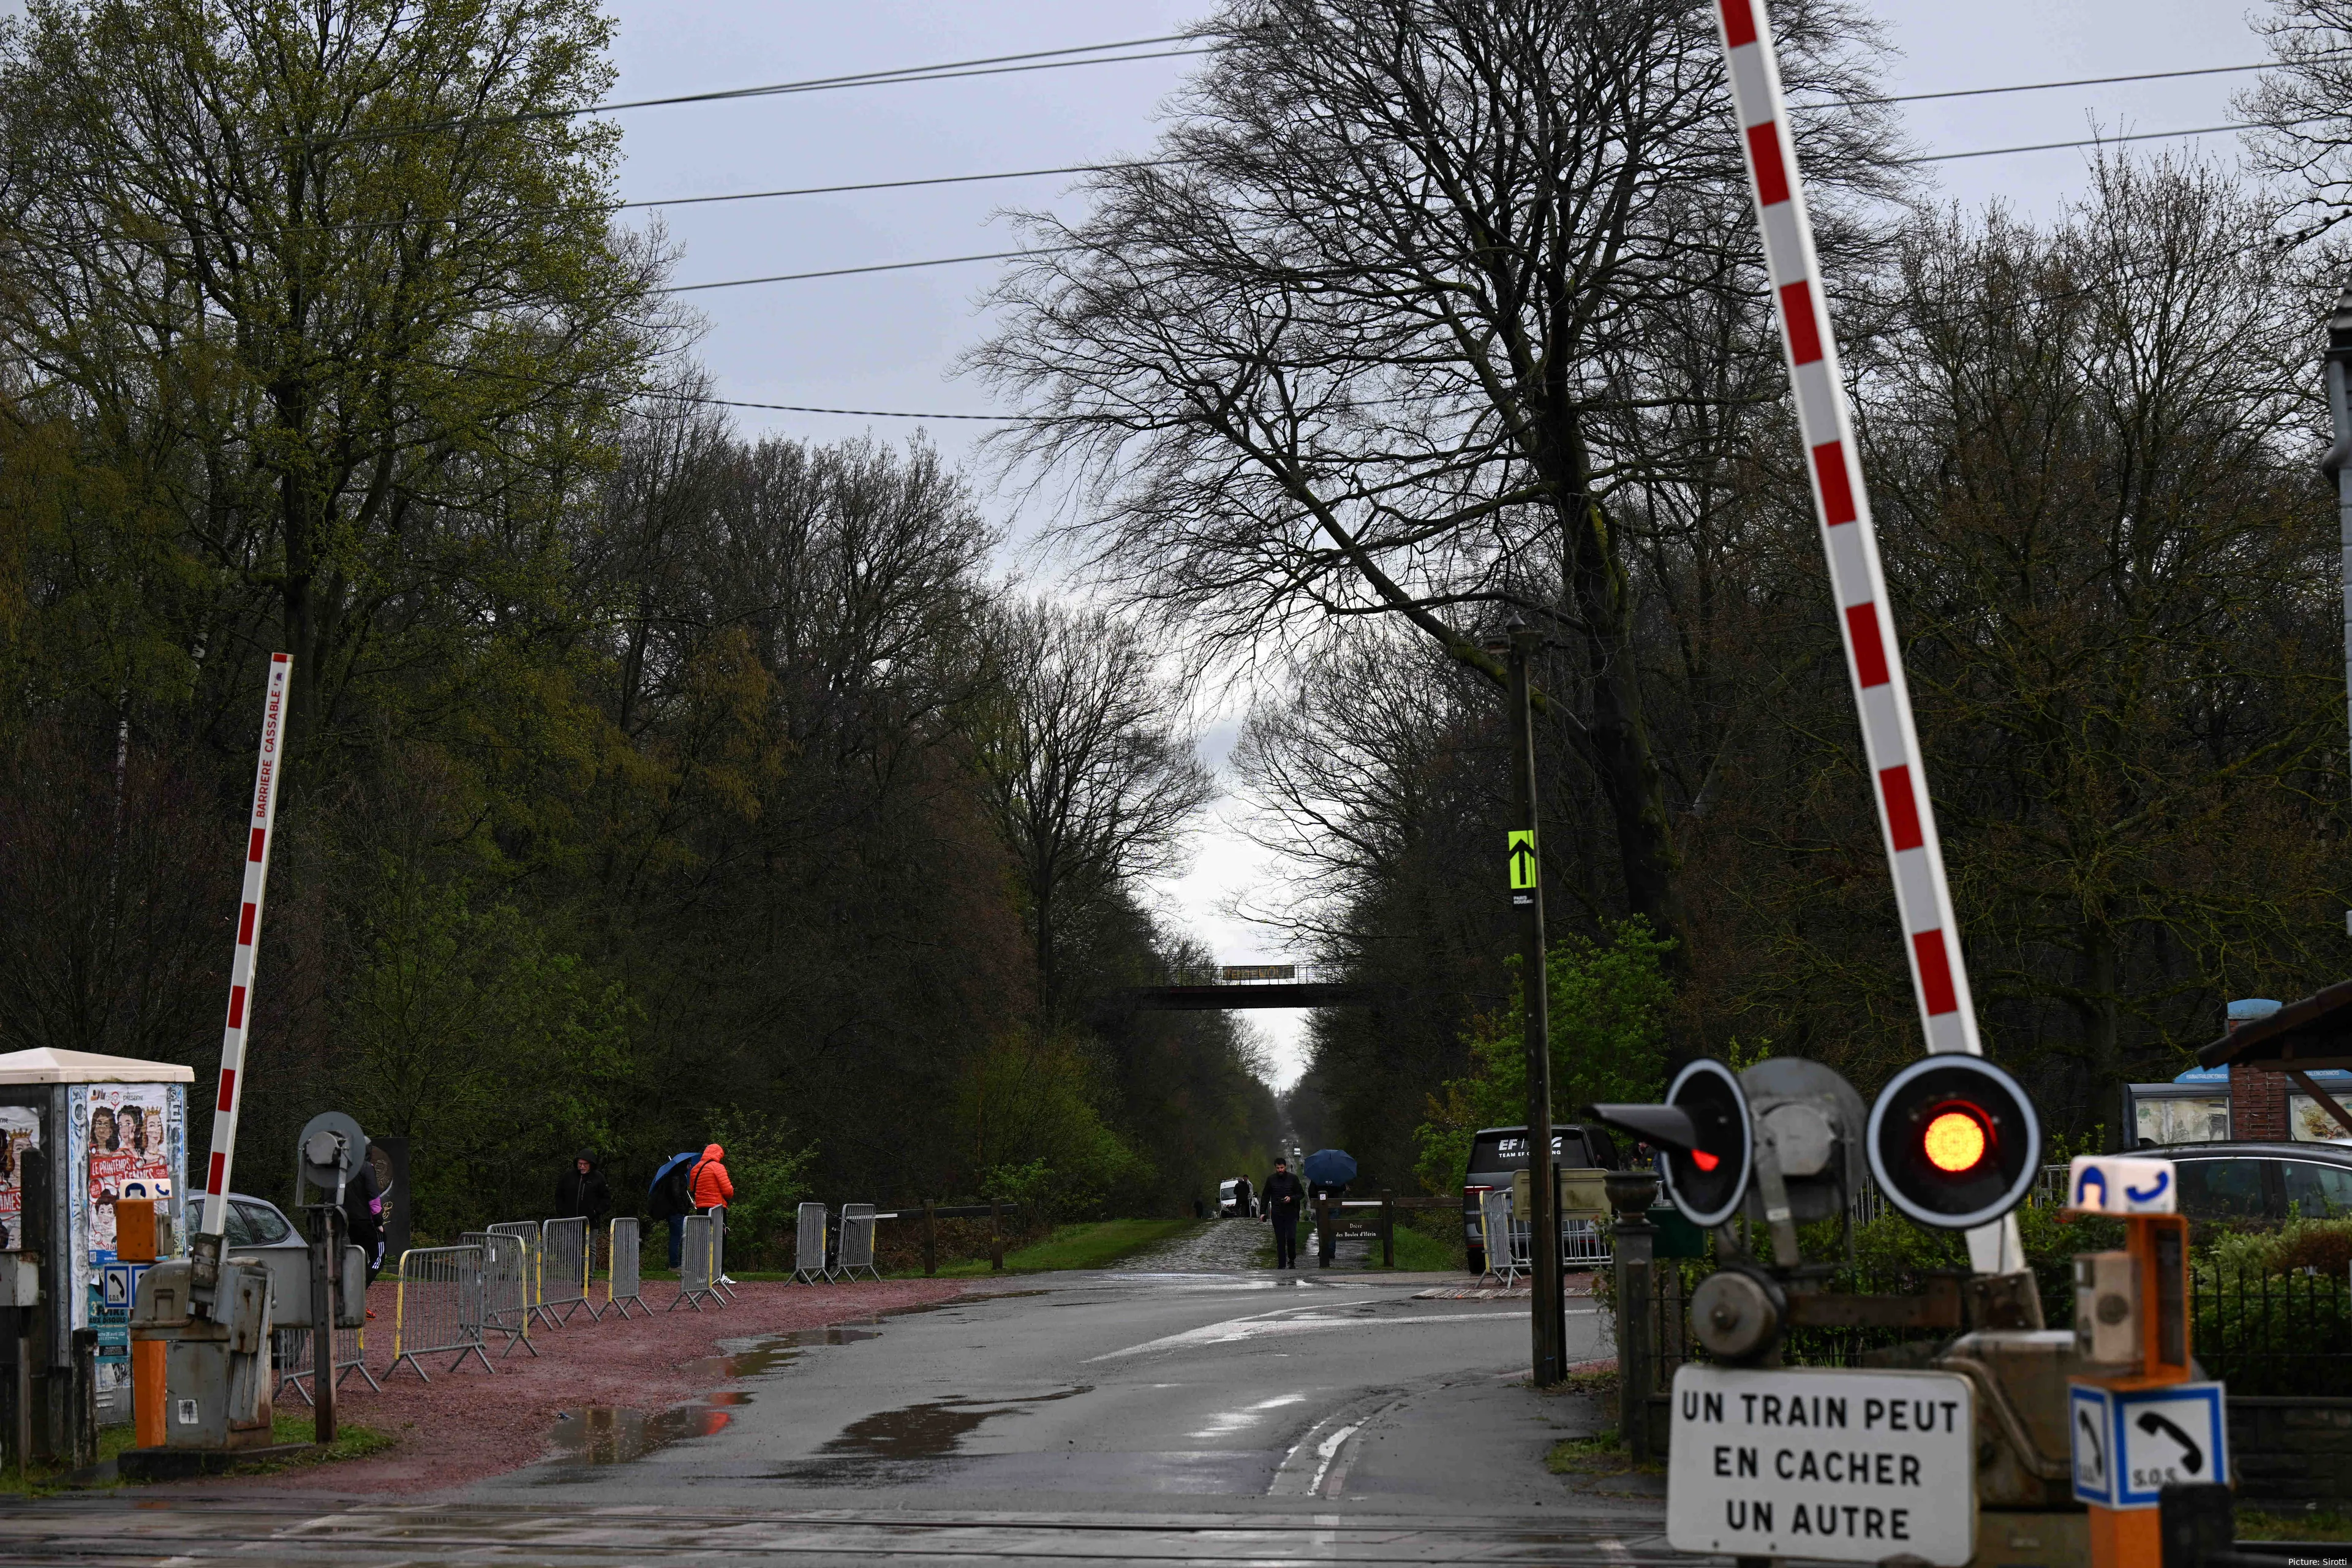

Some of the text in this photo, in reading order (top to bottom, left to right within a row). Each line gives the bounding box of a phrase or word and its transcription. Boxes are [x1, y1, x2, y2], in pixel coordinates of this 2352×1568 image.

[256, 690, 281, 818] BARRIERE CASSABLE
[1498, 1139, 1518, 1151] EF
[92, 1158, 130, 1175] LE PRINTEMPS
[124, 1168, 154, 1179] FEMMES
[1681, 1390, 1959, 1433] UN TRAIN PEUT
[1714, 1446, 1921, 1487] EN CACHER
[1727, 1500, 1910, 1541] UN AUTRE
